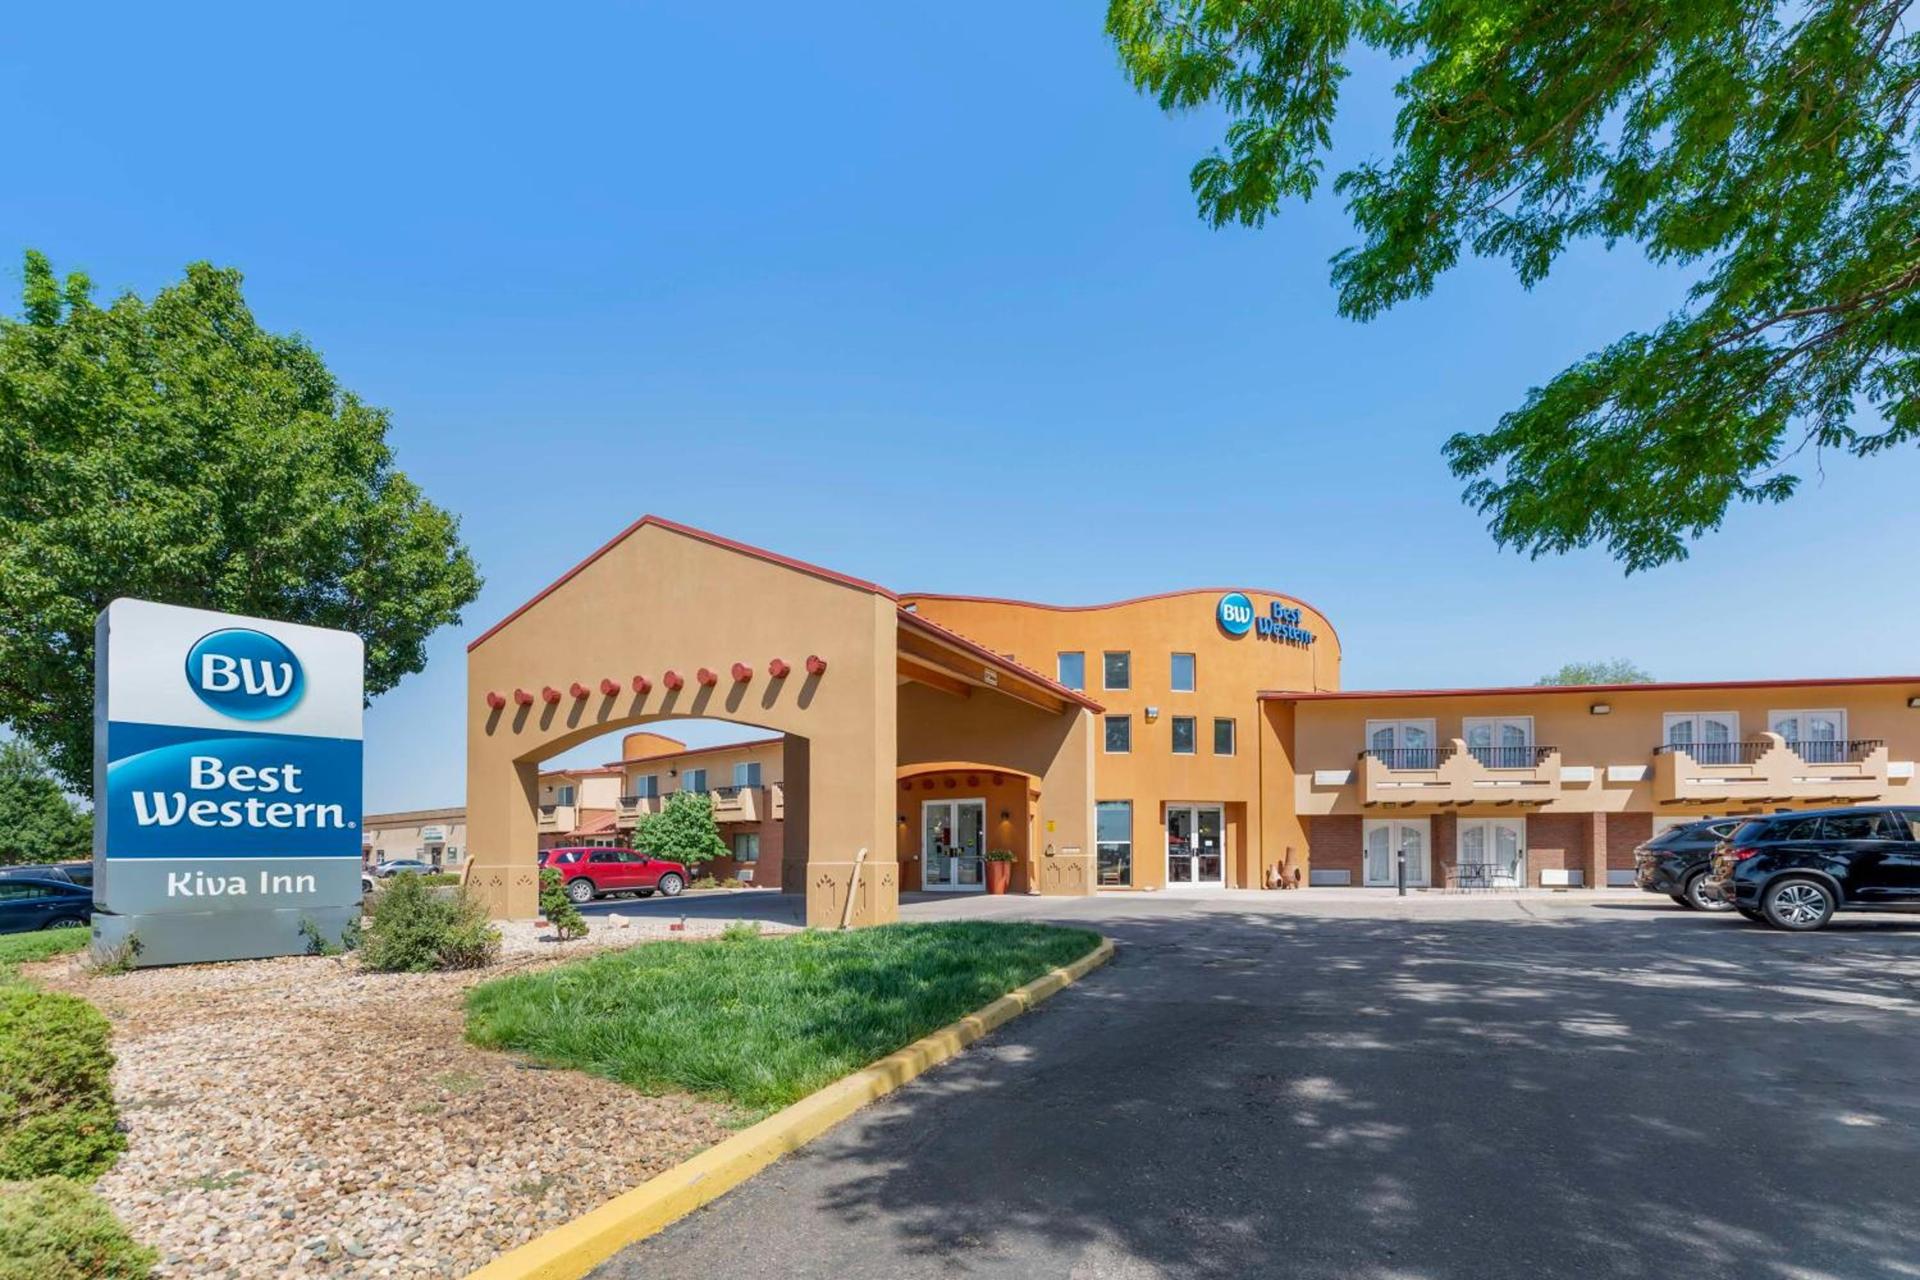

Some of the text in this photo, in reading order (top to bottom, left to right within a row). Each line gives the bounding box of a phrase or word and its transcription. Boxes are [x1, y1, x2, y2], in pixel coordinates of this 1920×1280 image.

[1223, 604, 1250, 623] BW
[1271, 601, 1300, 624] Best
[1256, 617, 1312, 644] Western
[202, 653, 293, 697] BW
[190, 756, 303, 793] Best
[168, 871, 317, 898] Kiva Inn
